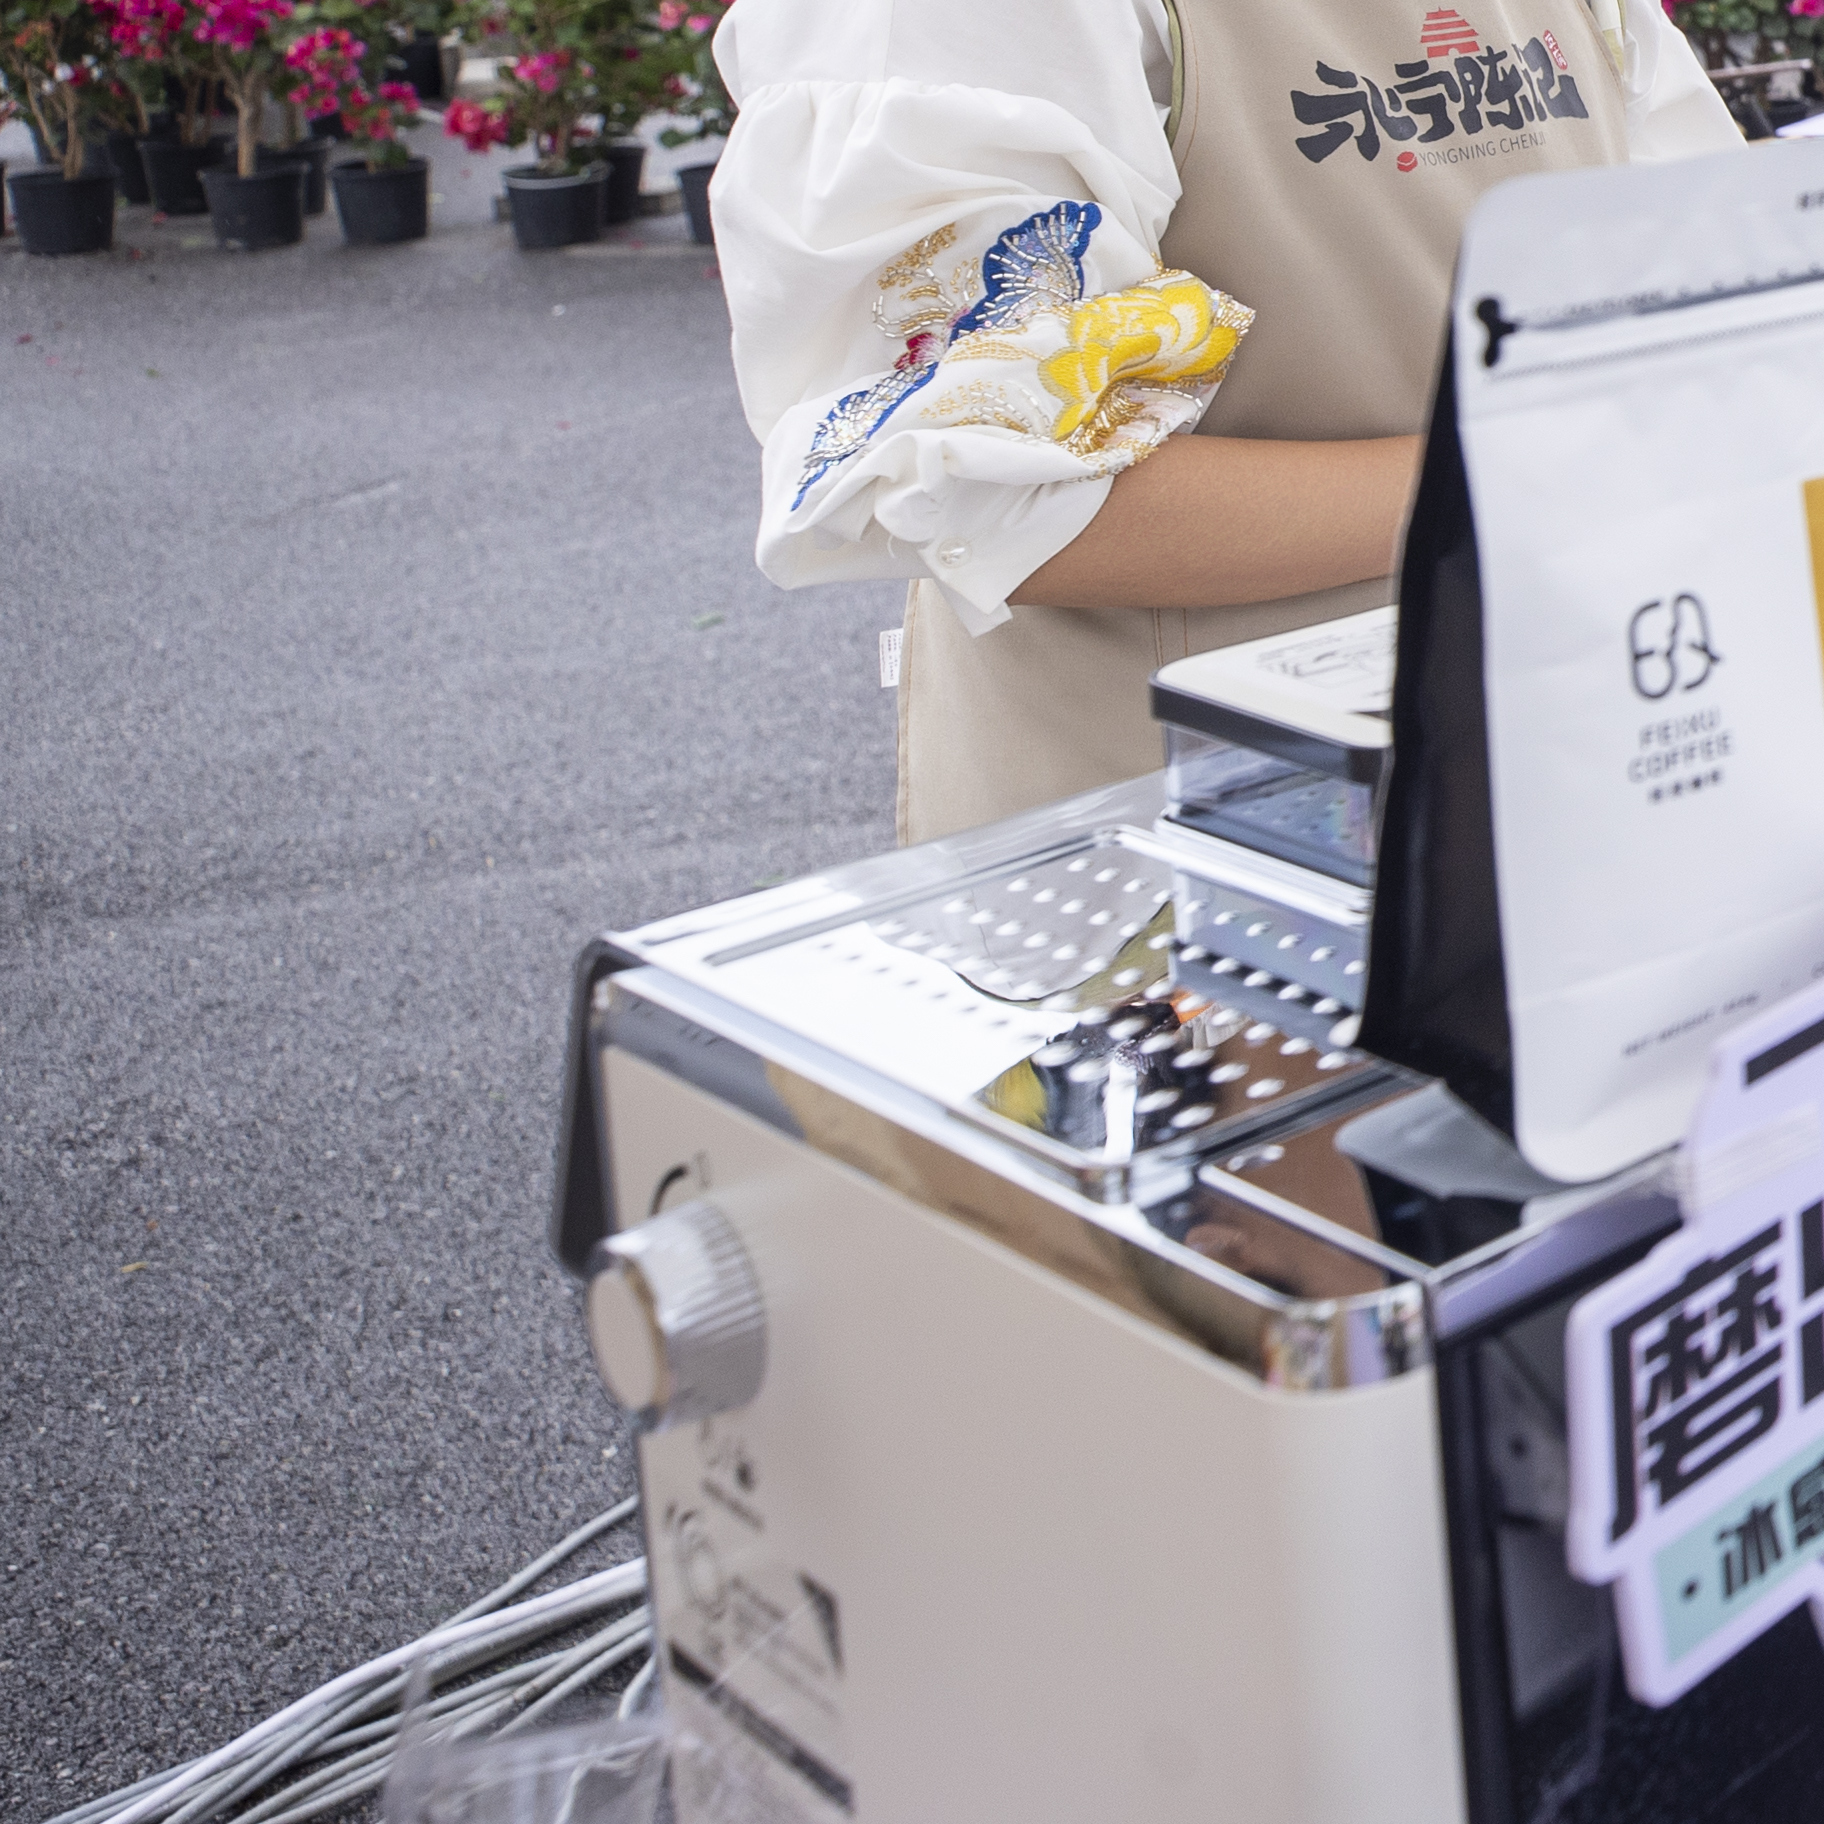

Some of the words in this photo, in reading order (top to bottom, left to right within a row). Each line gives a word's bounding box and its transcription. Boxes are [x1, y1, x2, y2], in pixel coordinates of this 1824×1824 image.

[1290, 36, 1590, 163] 永宁陈记
[1418, 140, 1497, 167] YONGNING
[1627, 729, 1733, 783] COFFEE
